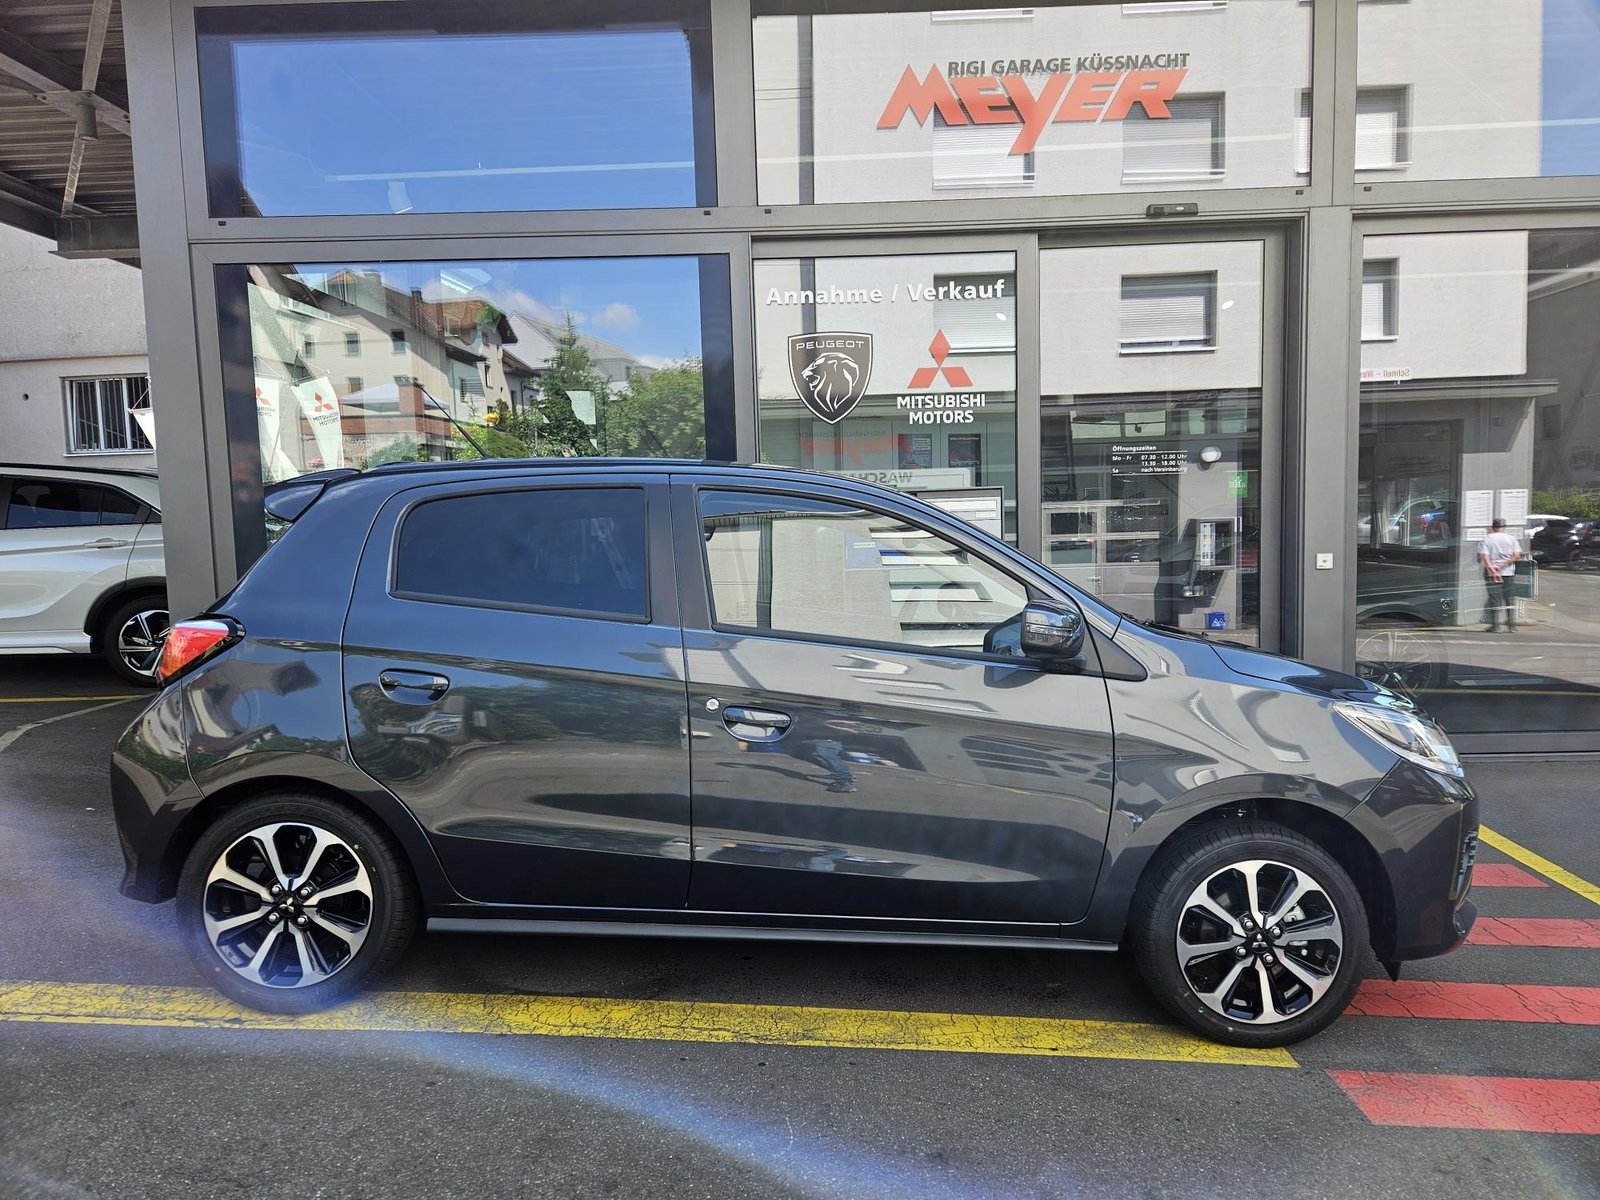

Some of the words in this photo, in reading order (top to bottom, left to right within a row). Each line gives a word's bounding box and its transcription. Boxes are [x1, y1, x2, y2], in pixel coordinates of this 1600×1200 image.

[947, 58, 986, 79] RIGI
[991, 56, 1072, 77] GARAGE
[1076, 52, 1190, 74] KÜSSNACHT
[876, 63, 1188, 156] MEYER
[765, 284, 883, 306] Annahme
[890, 283, 898, 303] /
[906, 279, 1006, 302] Verkauf
[796, 340, 865, 350] PEUGEOT
[896, 393, 986, 410] MITSUBISHI
[909, 410, 974, 425] MOTORS
